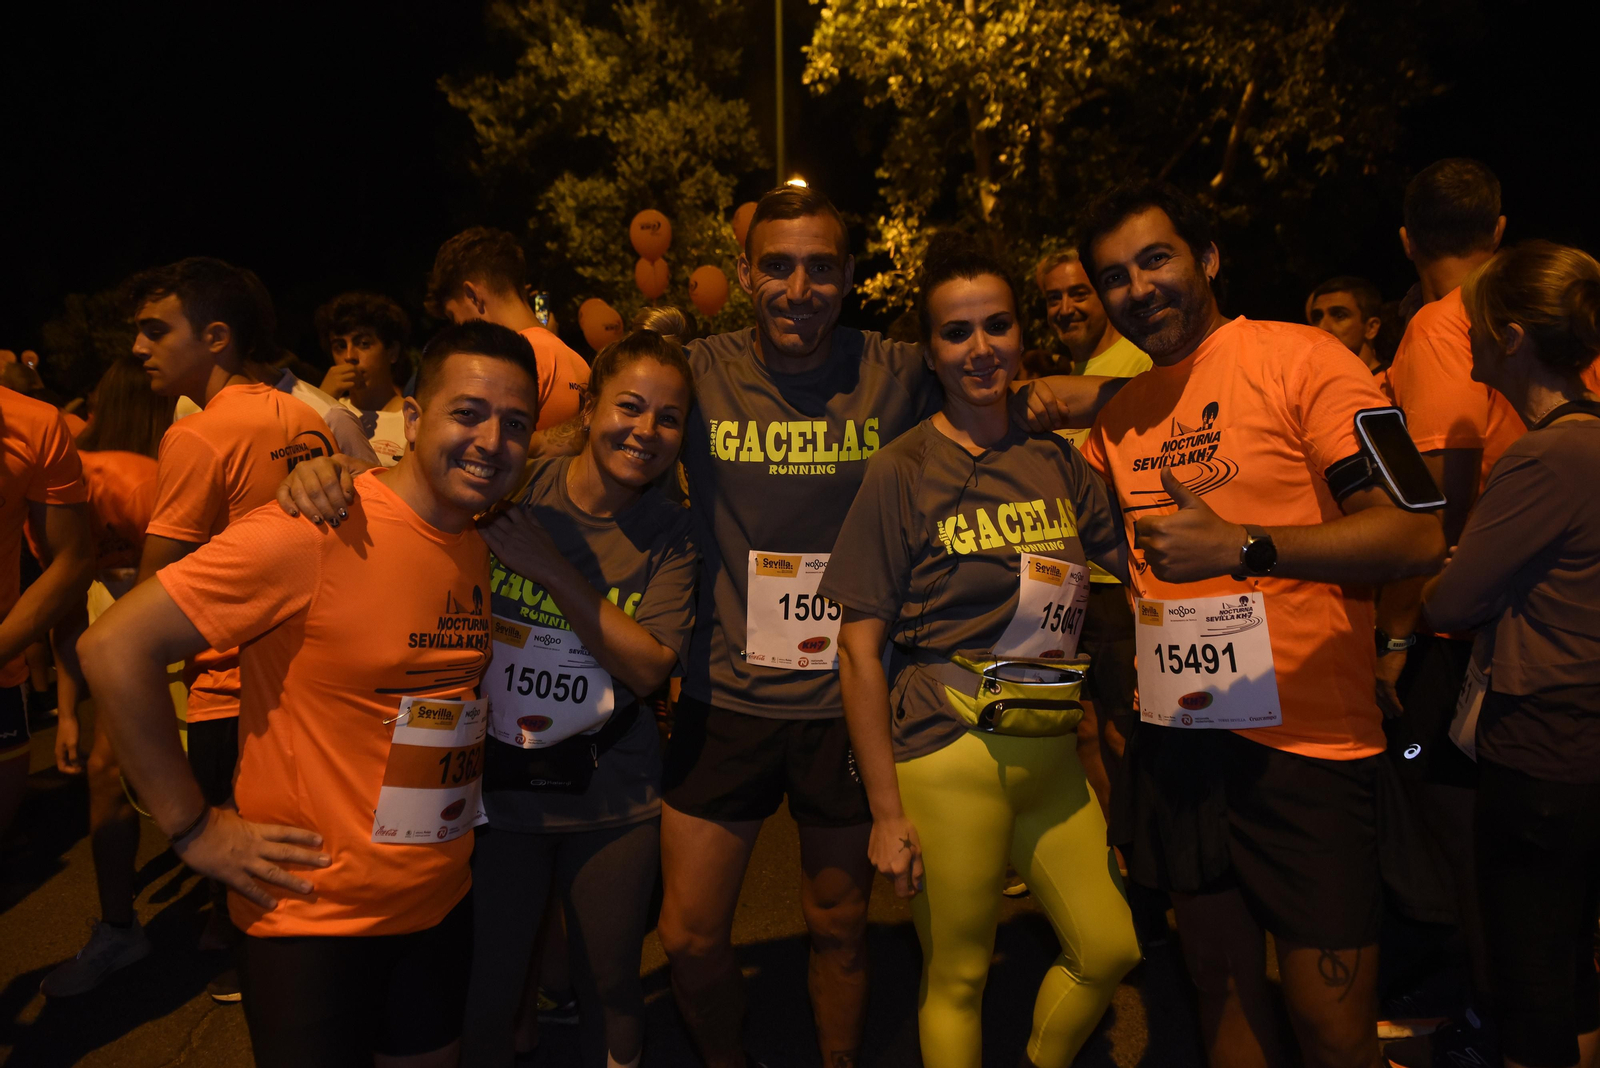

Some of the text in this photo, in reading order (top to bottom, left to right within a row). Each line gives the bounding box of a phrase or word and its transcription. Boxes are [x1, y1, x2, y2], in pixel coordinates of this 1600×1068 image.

[715, 417, 880, 463] GACELAS
[1161, 431, 1221, 452] NOCTURNA
[270, 442, 309, 461] NOCTURNA
[768, 464, 836, 475] RUNNING
[1132, 453, 1187, 472] SEVILLA
[1012, 540, 1065, 554] RUNNING
[1040, 602, 1083, 635] 15047
[1205, 614, 1235, 622] SEVILLA
[1219, 607, 1253, 615] NOCTURNA
[437, 616, 489, 631] NOCTURNA
[408, 632, 464, 649] SEVILLA
[1155, 642, 1237, 675] 15491
[504, 663, 588, 703] 15050
